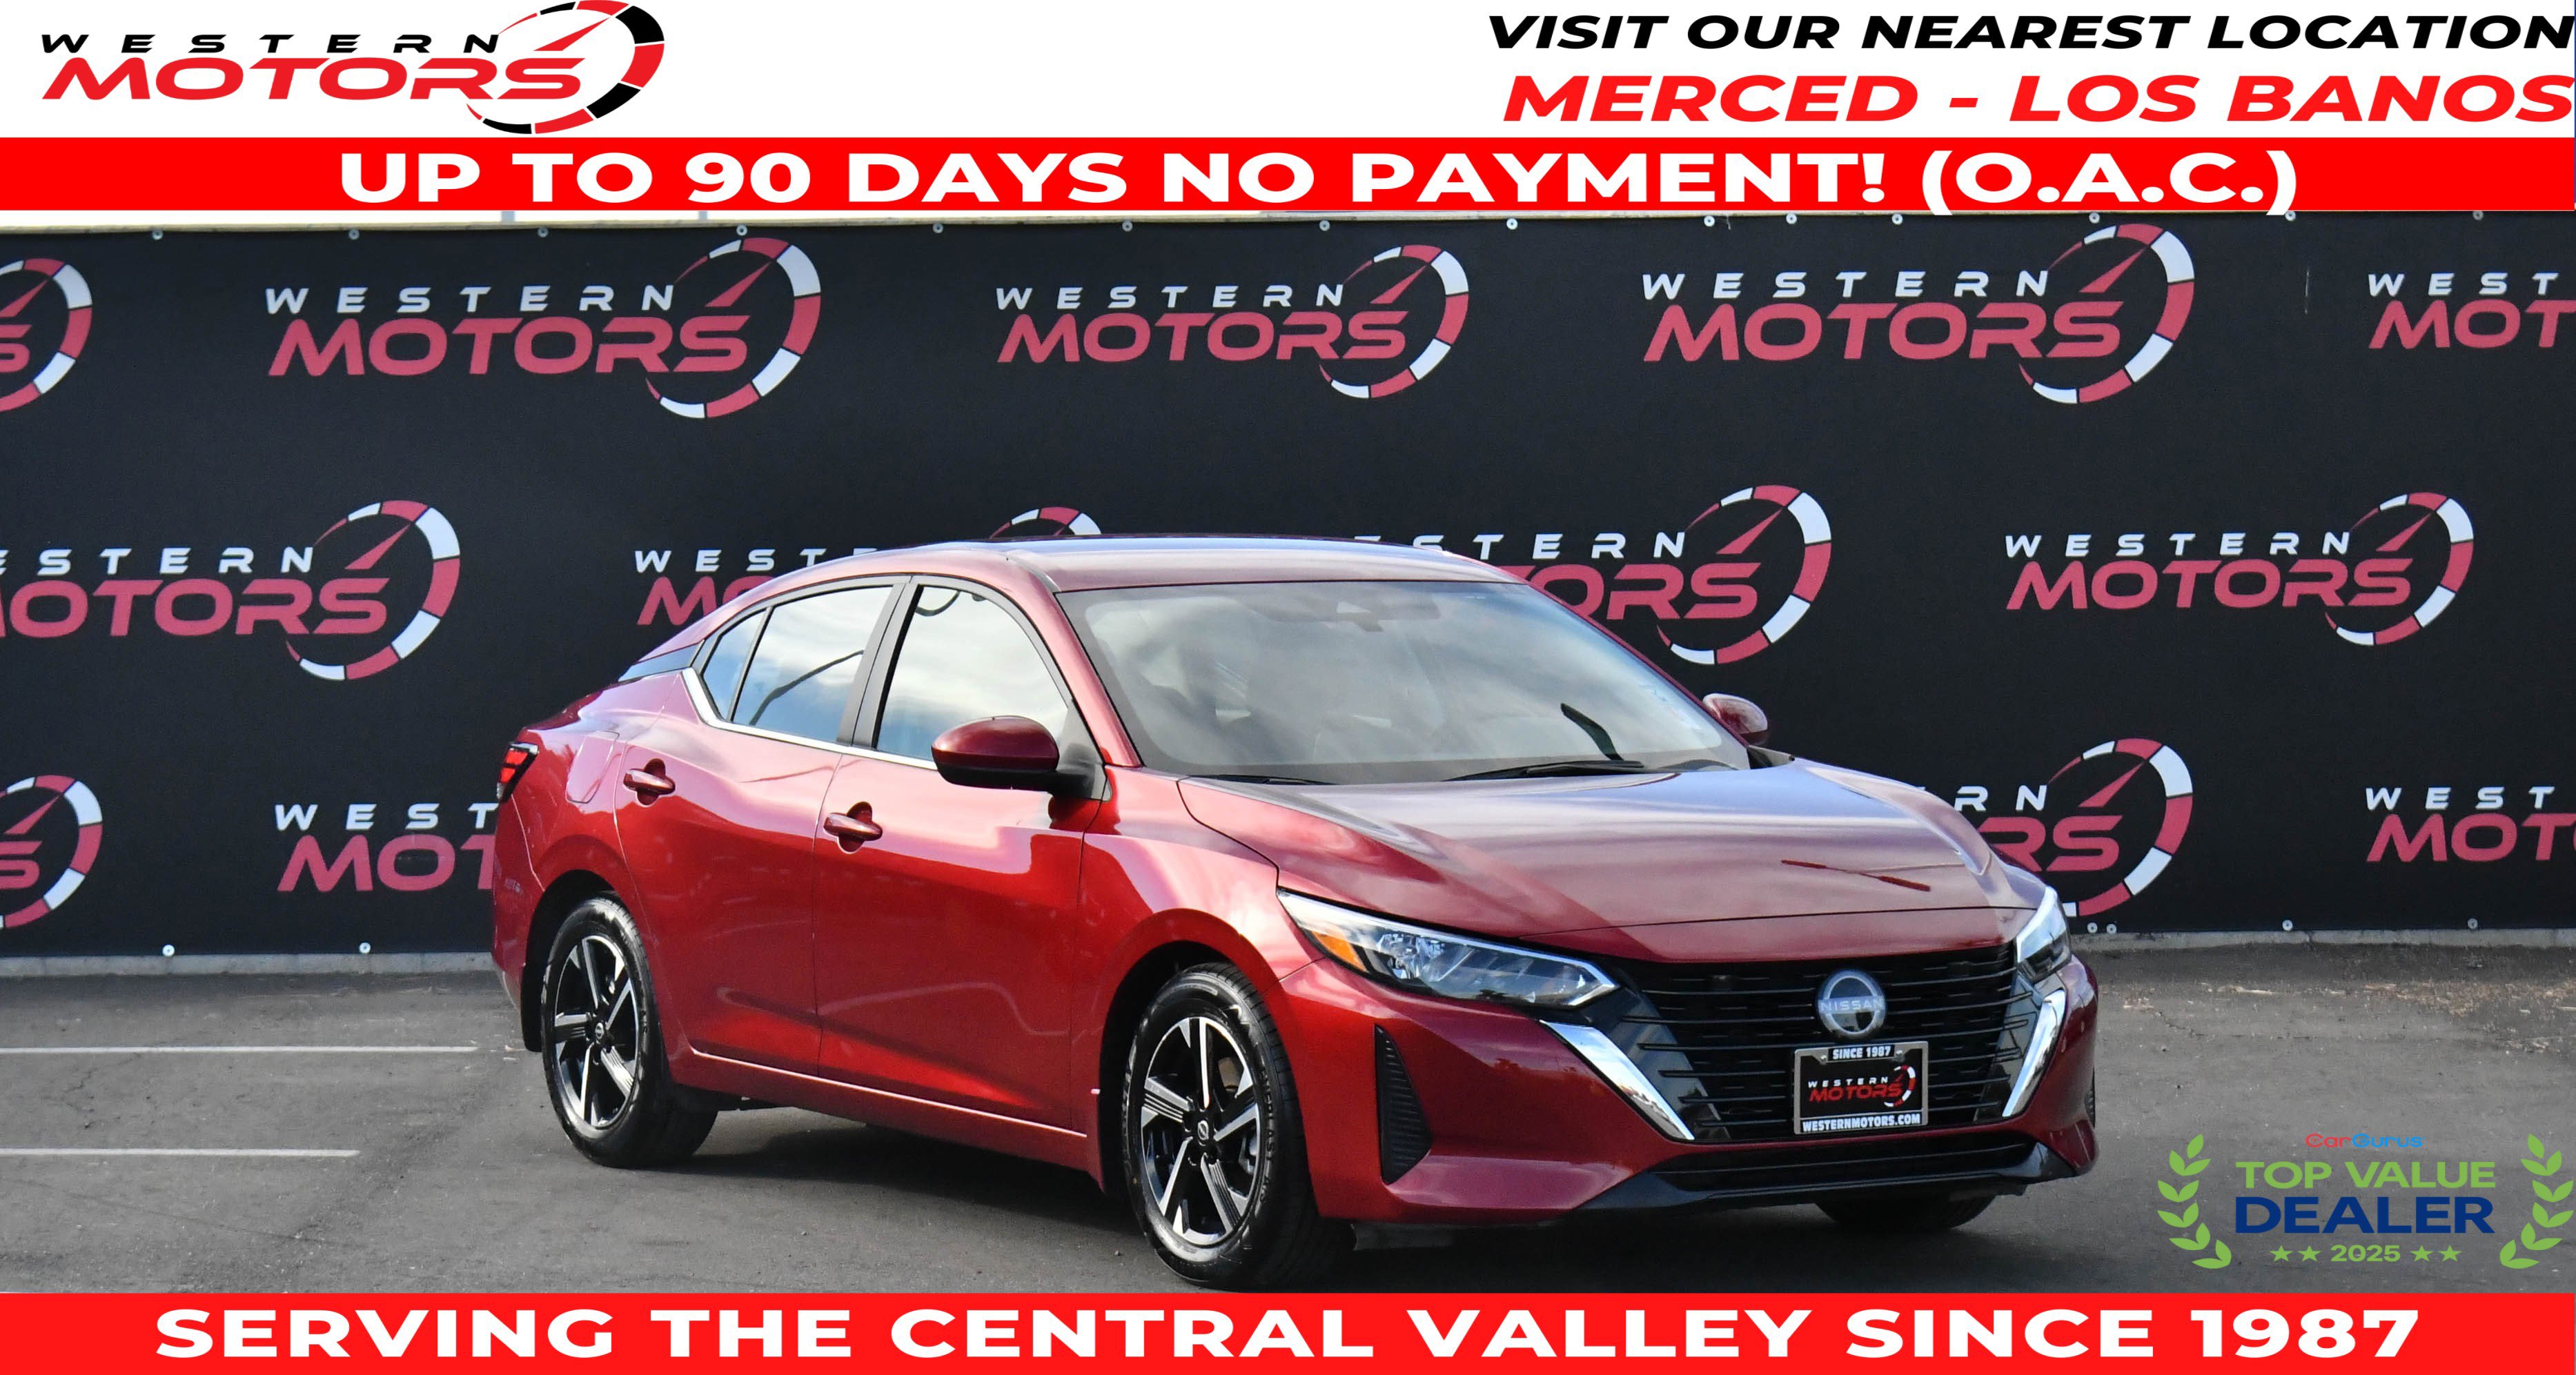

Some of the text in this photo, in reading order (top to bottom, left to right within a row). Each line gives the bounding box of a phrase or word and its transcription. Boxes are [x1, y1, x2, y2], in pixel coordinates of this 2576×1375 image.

[997, 284, 1343, 309] WESTERN
[1643, 271, 2047, 299] WESTERN
[2369, 273, 2557, 296] WEST
[267, 286, 673, 313] WESTERN
[999, 311, 1408, 363] MOTORS
[1644, 301, 2122, 362] MOTORS
[2370, 299, 2576, 348] MOT
[270, 316, 749, 376] MOTORS
[1355, 533, 1684, 560] STERN
[2006, 533, 2349, 557] WESTERN
[0, 547, 313, 575] STERN
[636, 548, 877, 573] WEST
[1497, 563, 1760, 621] ORS
[2007, 559, 2412, 609] MOTORS
[0, 578, 389, 637] OTORS
[2366, 787, 2554, 810] WEST
[276, 804, 498, 830] WEST
[2368, 813, 2576, 861] MOT
[279, 835, 494, 892] MOT
[1820, 999, 1885, 1012] NISSAN
[1832, 1045, 1891, 1060] SINCE 1987
[1808, 1076, 1889, 1088] WESTERN
[1809, 1082, 1904, 1102] MOTORS
[1802, 1113, 1921, 1132] WESTERNMOTORS.COM
